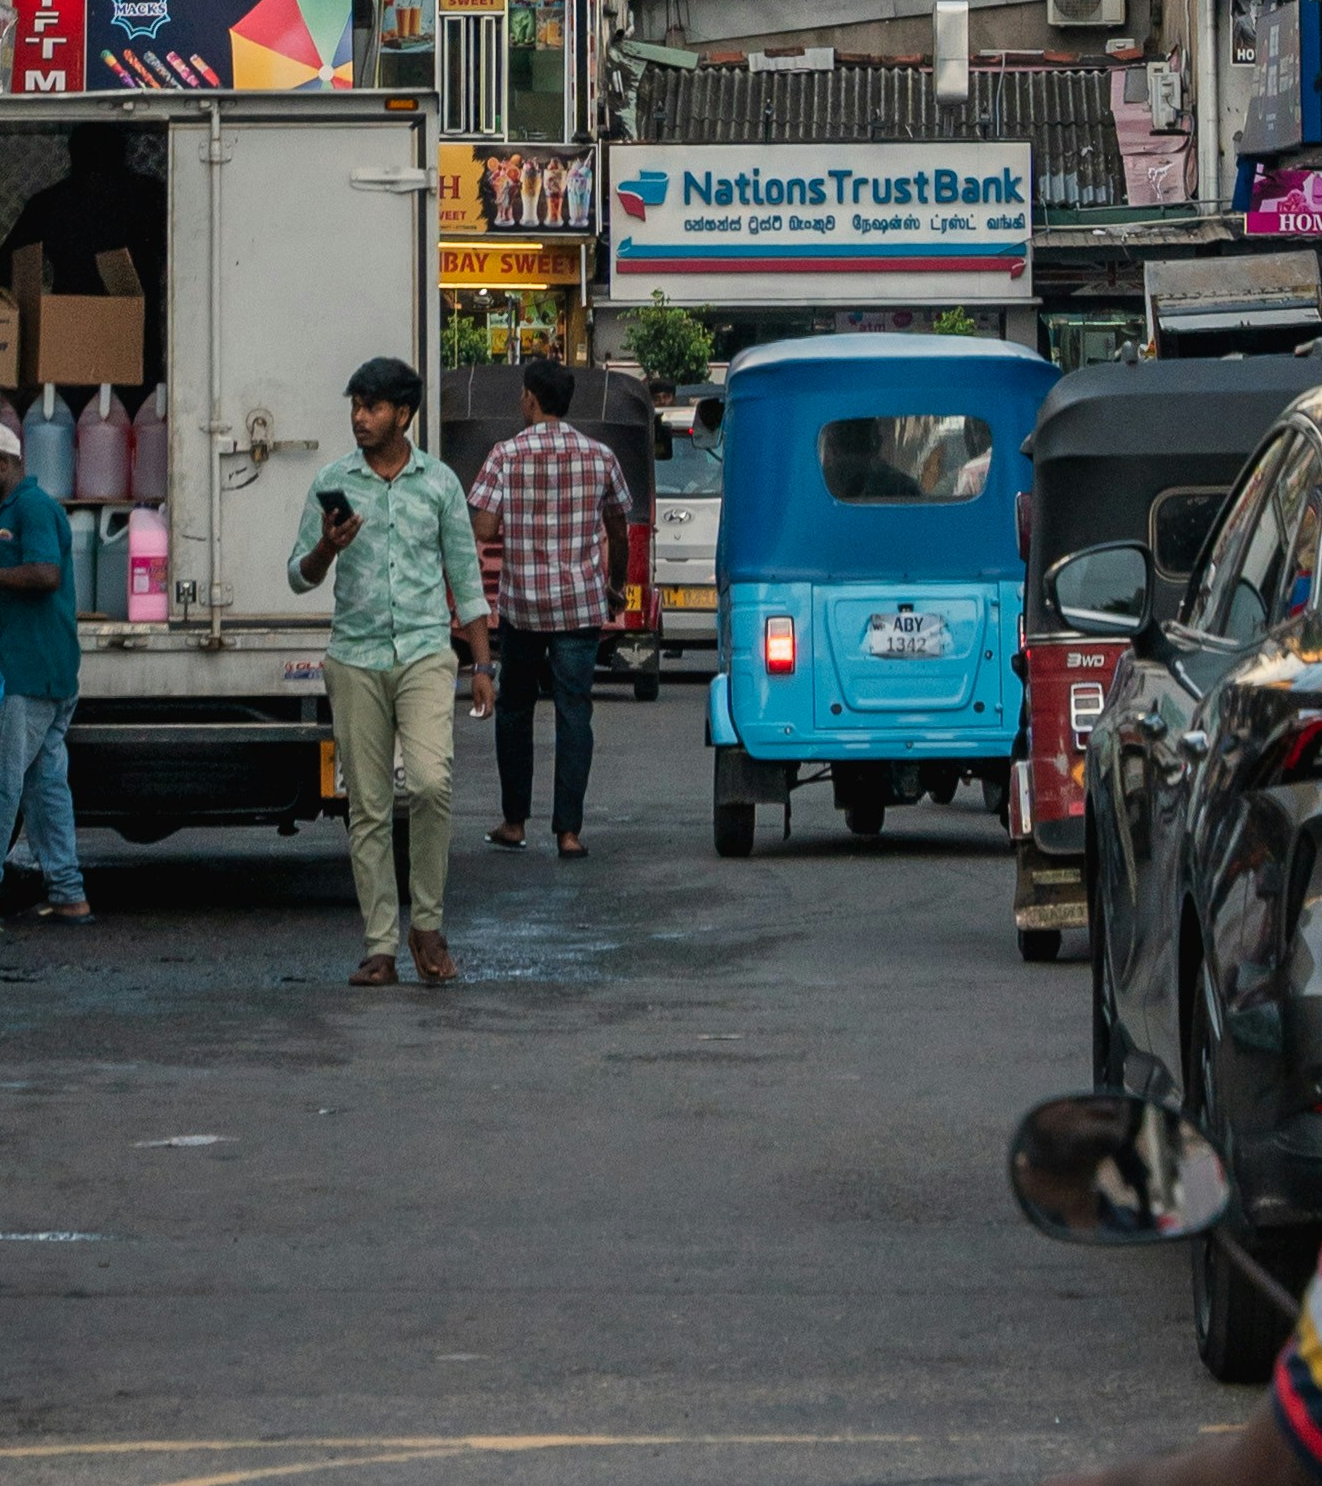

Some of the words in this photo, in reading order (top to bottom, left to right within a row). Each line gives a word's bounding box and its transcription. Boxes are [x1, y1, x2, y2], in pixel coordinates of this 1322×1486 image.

[114, 2, 168, 17] MACKS
[930, 213, 977, 234] ட்ரஸ்ட்
[986, 212, 1026, 230] வங்கி
[440, 252, 489, 273] BAY
[500, 253, 578, 274] SWEET
[893, 617, 924, 633] ABY
[887, 637, 927, 653] 1342
